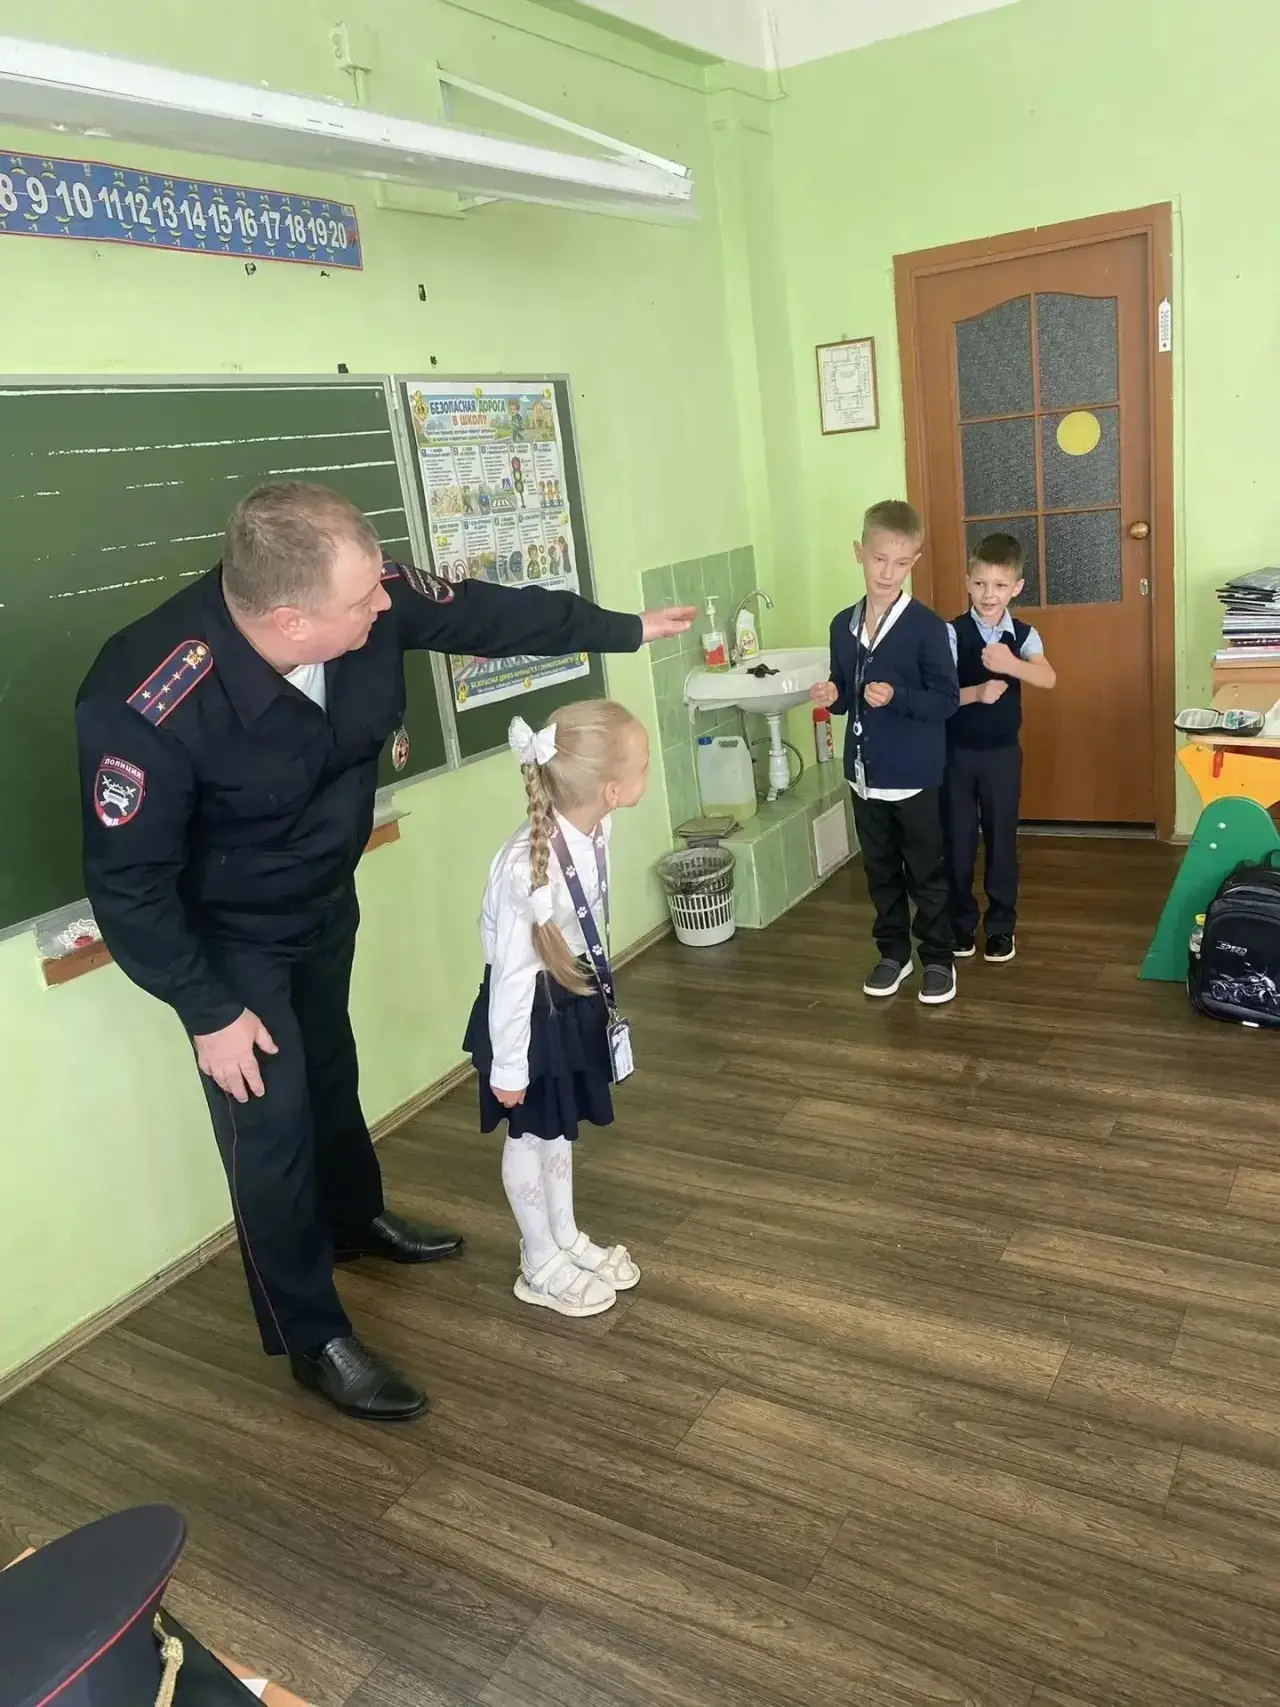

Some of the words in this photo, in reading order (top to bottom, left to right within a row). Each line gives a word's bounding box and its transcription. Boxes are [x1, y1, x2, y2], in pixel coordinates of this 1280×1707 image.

[0, 173, 18, 212] 8
[26, 176, 48, 214] 9
[56, 180, 93, 218] 10
[98, 186, 124, 220] 11
[124, 190, 152, 225] 12
[153, 195, 178, 229] 13
[180, 199, 207, 231] 14
[208, 203, 233, 235] 15
[235, 206, 258, 237] 16
[260, 210, 280, 240] 17
[285, 213, 306, 244] 18
[308, 217, 328, 246] 19
[329, 220, 347, 249] 20
[429, 399, 477, 415] БЕЗОПАСНАЯ
[479, 399, 506, 414] ДОРОГА
[452, 415, 458, 426] В
[460, 414, 487, 426] ШКОЛУ
[104, 758, 142, 780] ПОЛИЦИЯ
[1216, 941, 1248, 957] SPEED
